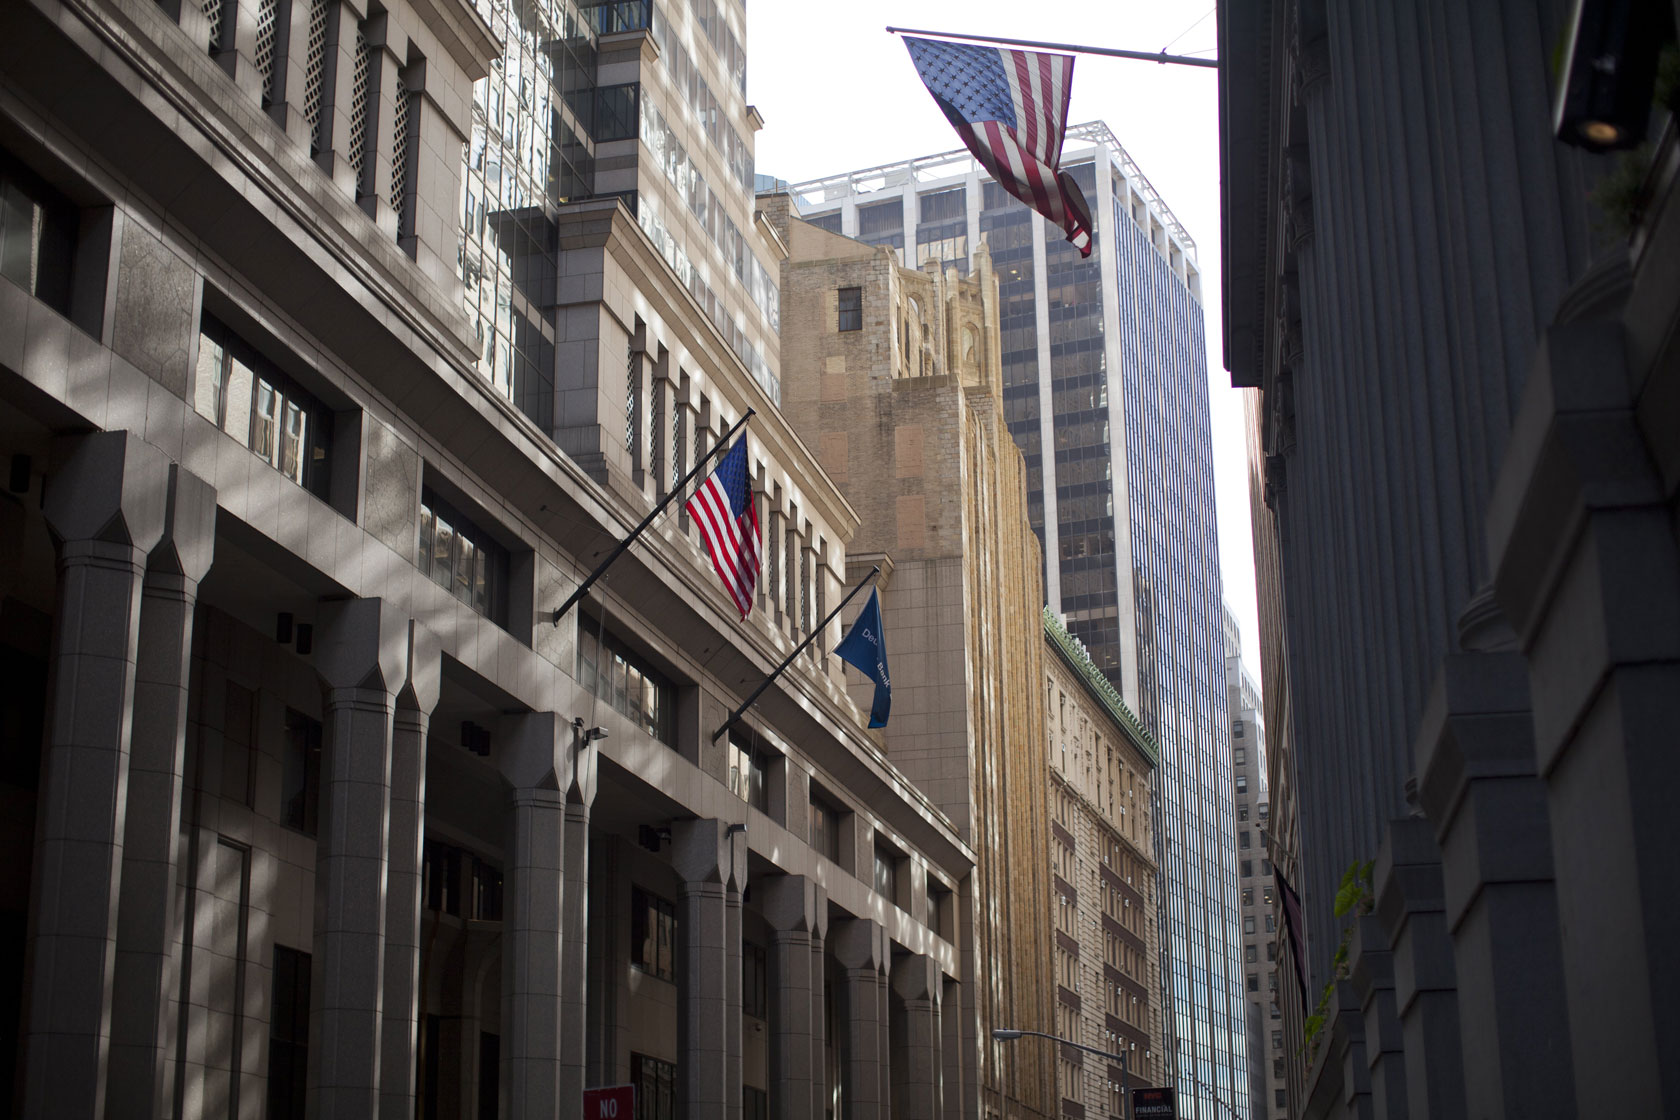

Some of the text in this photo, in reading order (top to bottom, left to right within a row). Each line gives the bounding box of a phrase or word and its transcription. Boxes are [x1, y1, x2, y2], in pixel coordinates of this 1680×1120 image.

[877, 662, 891, 688] Bank
[600, 1098, 617, 1119] NO
[1135, 1105, 1173, 1114] FINANCIAL
